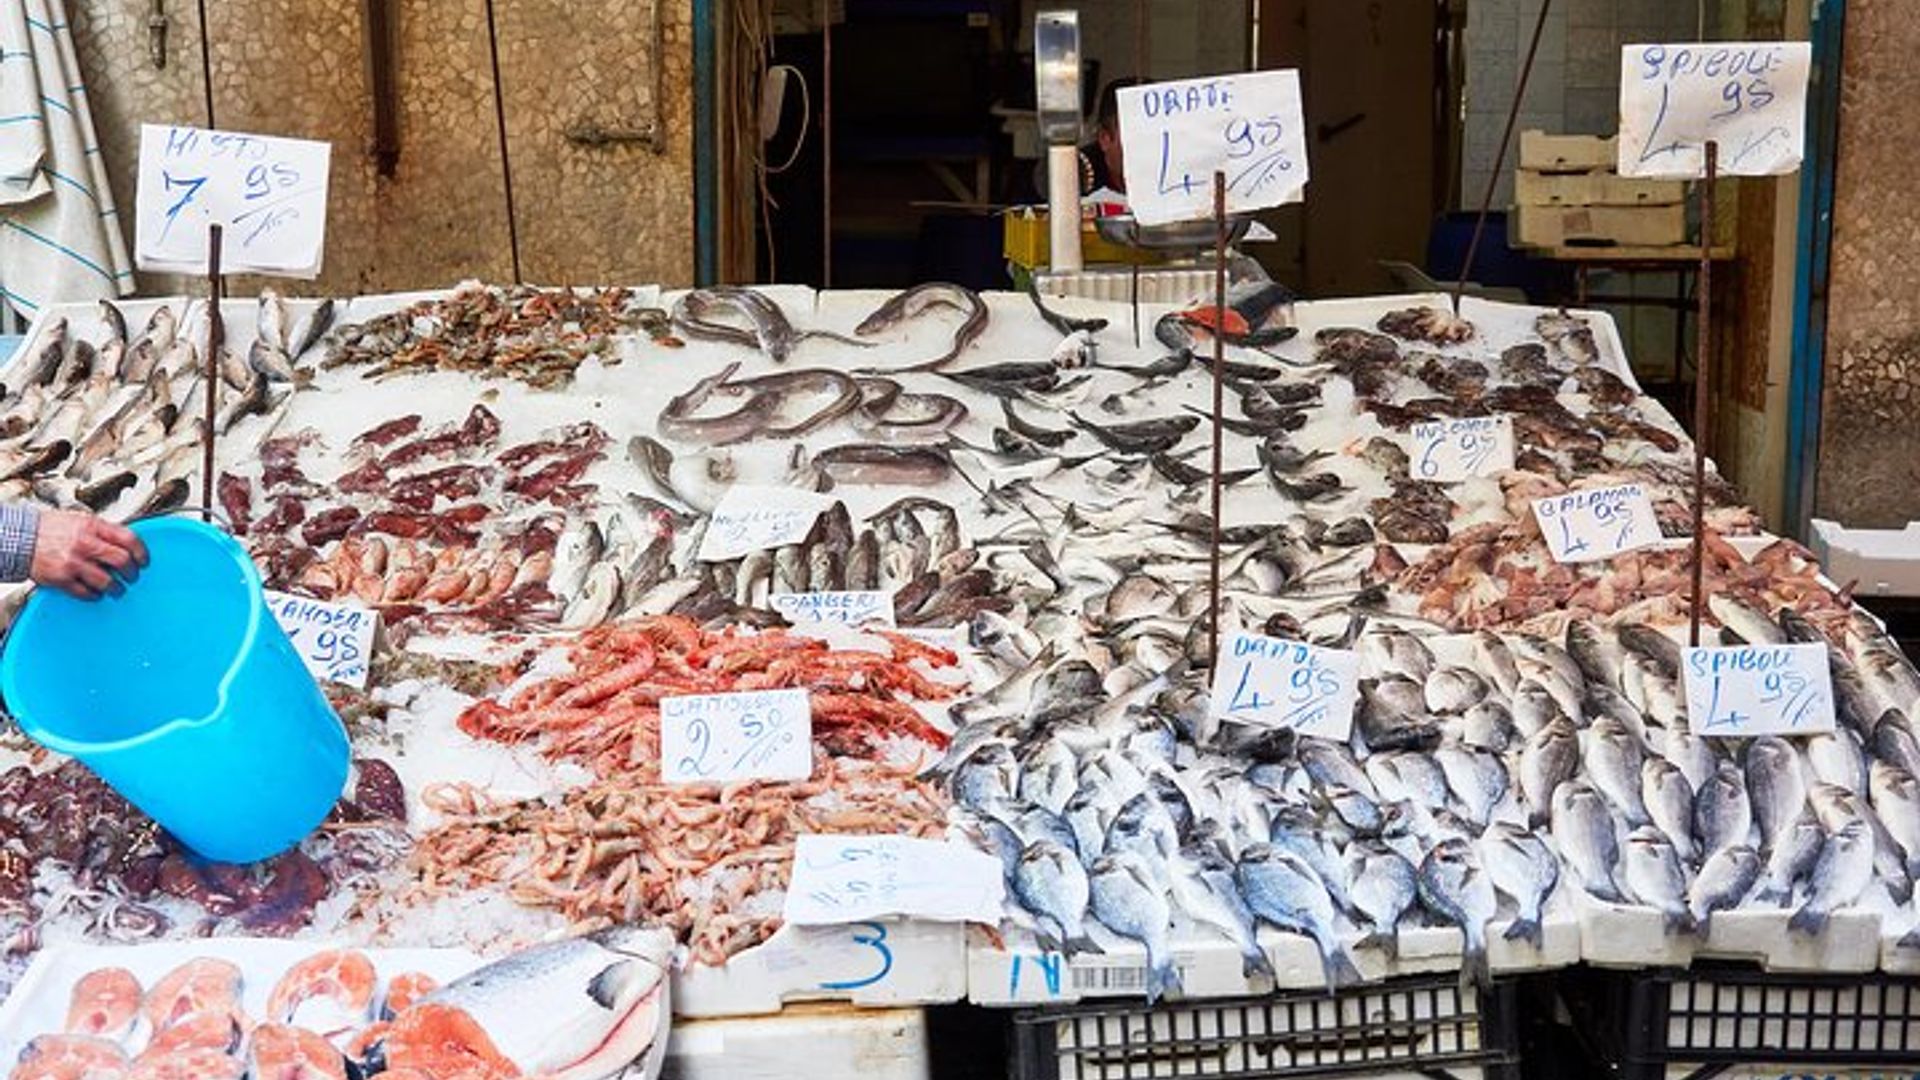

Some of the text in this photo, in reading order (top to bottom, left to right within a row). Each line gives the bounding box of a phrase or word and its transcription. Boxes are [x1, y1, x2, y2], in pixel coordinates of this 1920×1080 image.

[1421, 437, 1446, 477] 6
[311, 630, 359, 661] 95
[1229, 661, 1340, 711] 4 95
[1706, 676, 1750, 727] 4
[819, 922, 892, 989] 3
